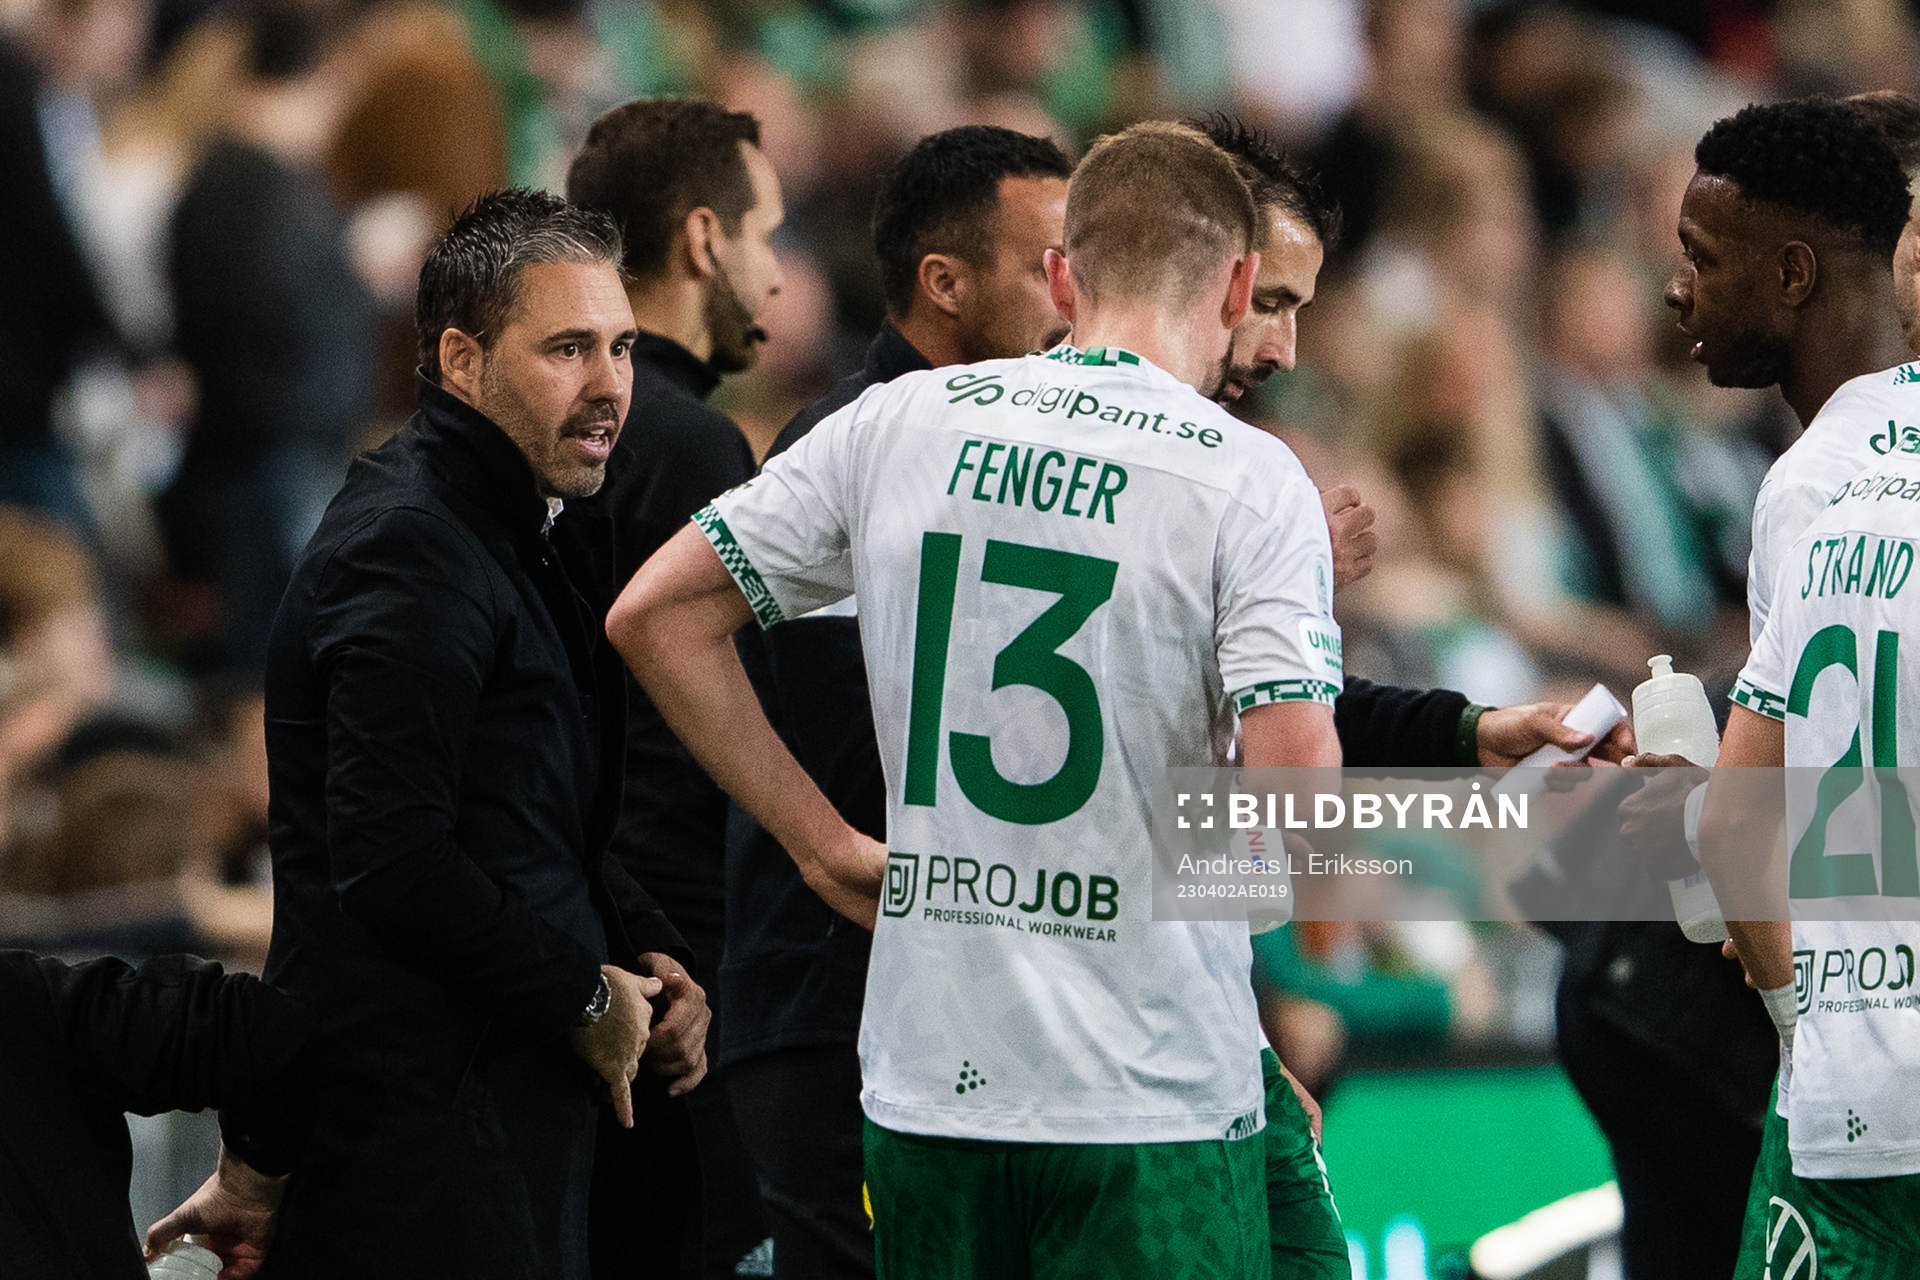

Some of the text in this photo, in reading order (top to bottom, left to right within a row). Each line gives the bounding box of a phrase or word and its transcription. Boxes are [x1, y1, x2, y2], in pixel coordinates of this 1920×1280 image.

[1011, 382, 1224, 449] digipant.se
[946, 439, 1129, 525] FENGER
[1801, 534, 1914, 600] STRAND
[904, 530, 1119, 826] 13
[1786, 623, 1920, 900] 21
[925, 854, 1120, 922] PROJOB
[923, 907, 1117, 943] PROFESSIONAL WORKWEAR
